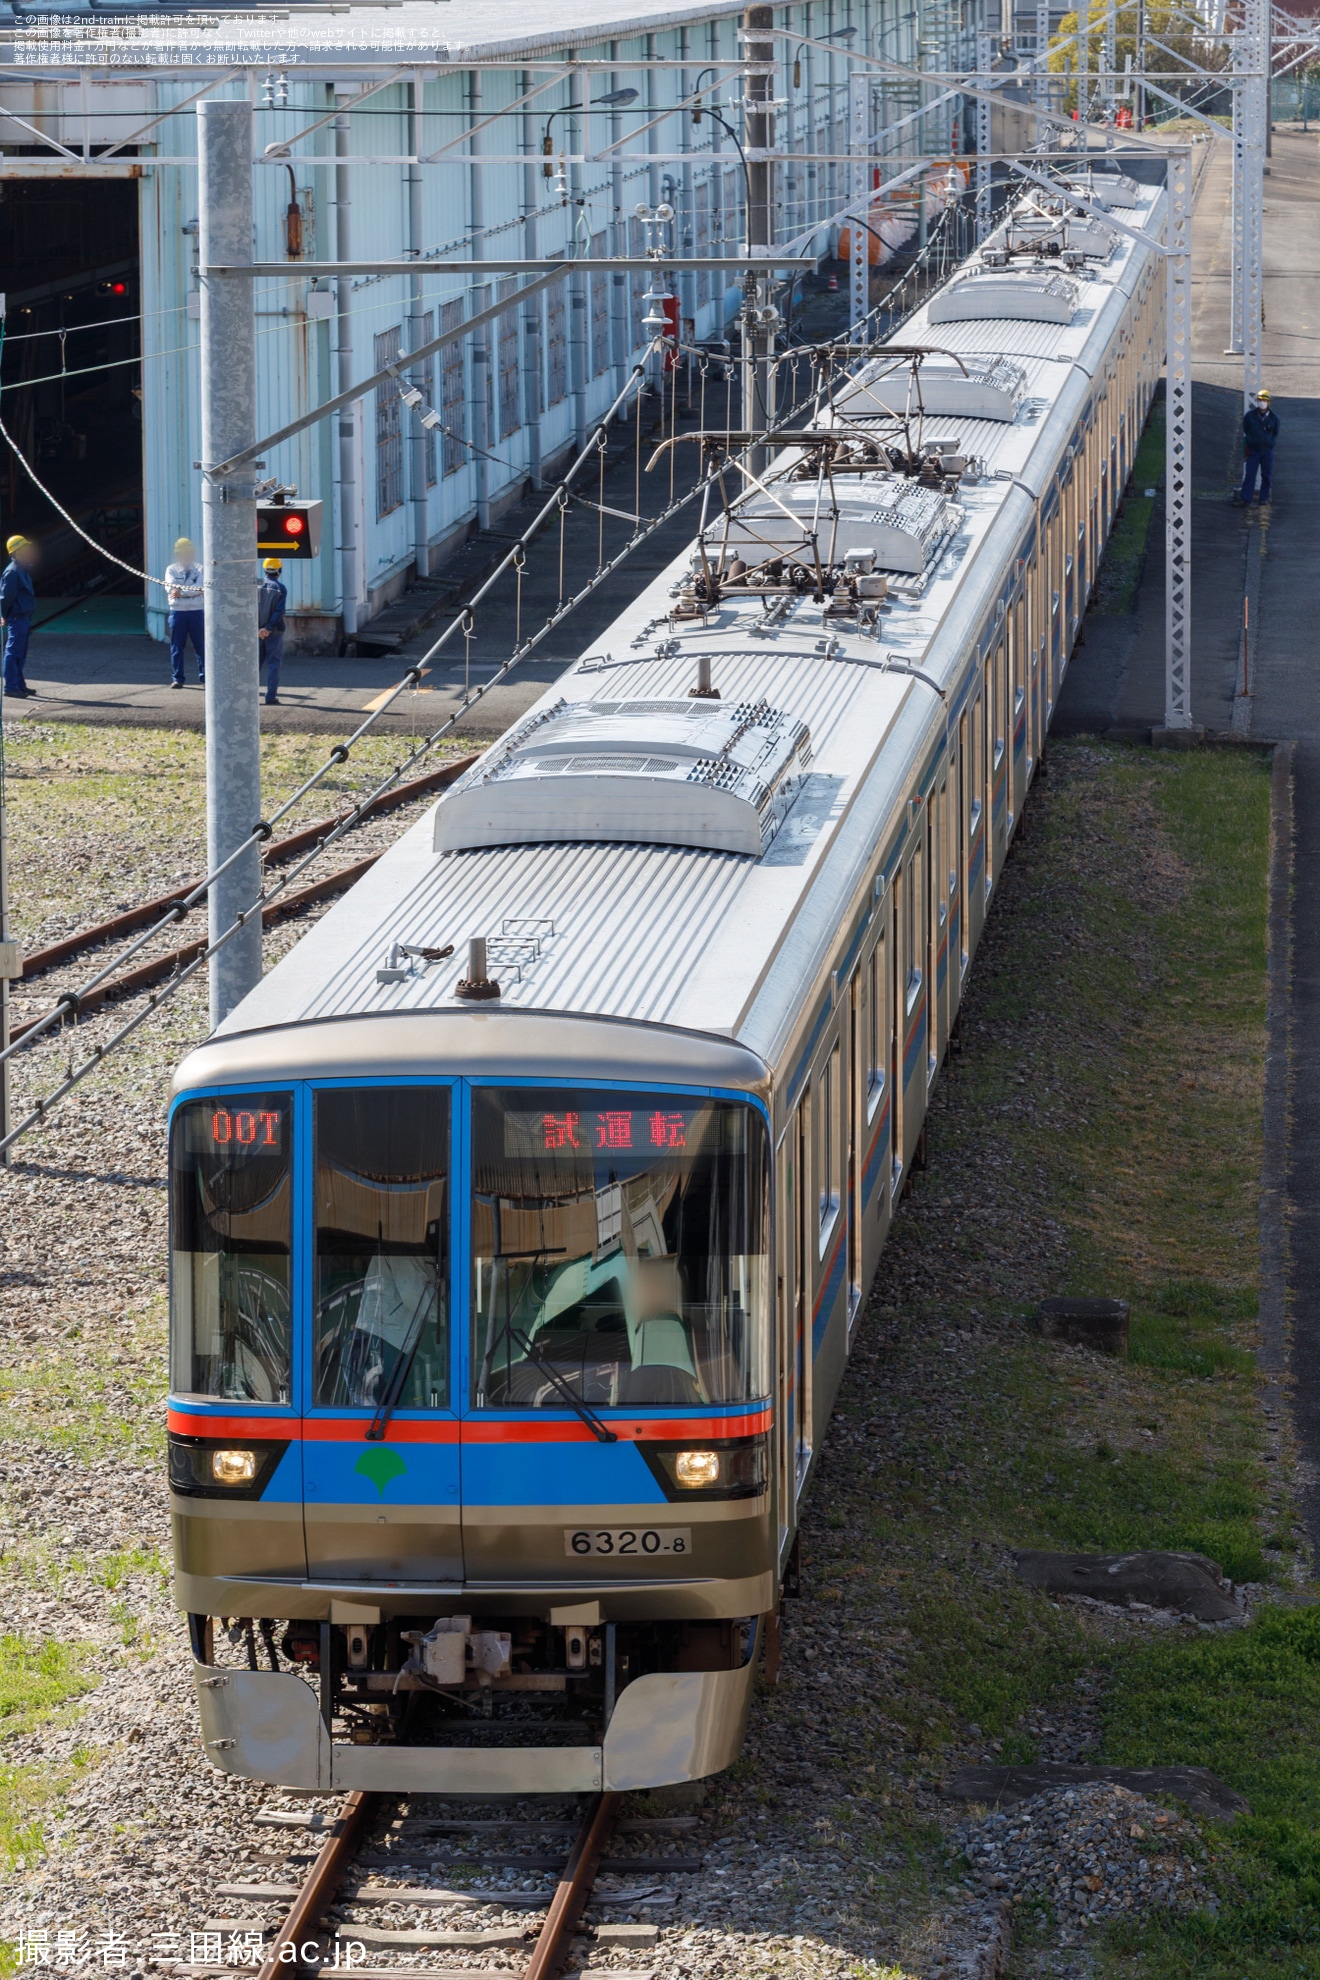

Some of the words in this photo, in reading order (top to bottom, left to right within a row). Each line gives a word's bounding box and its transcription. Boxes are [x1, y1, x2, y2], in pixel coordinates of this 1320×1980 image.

[543, 1111, 686, 1149] 試運転
[571, 1531, 686, 1554] 6320-8
